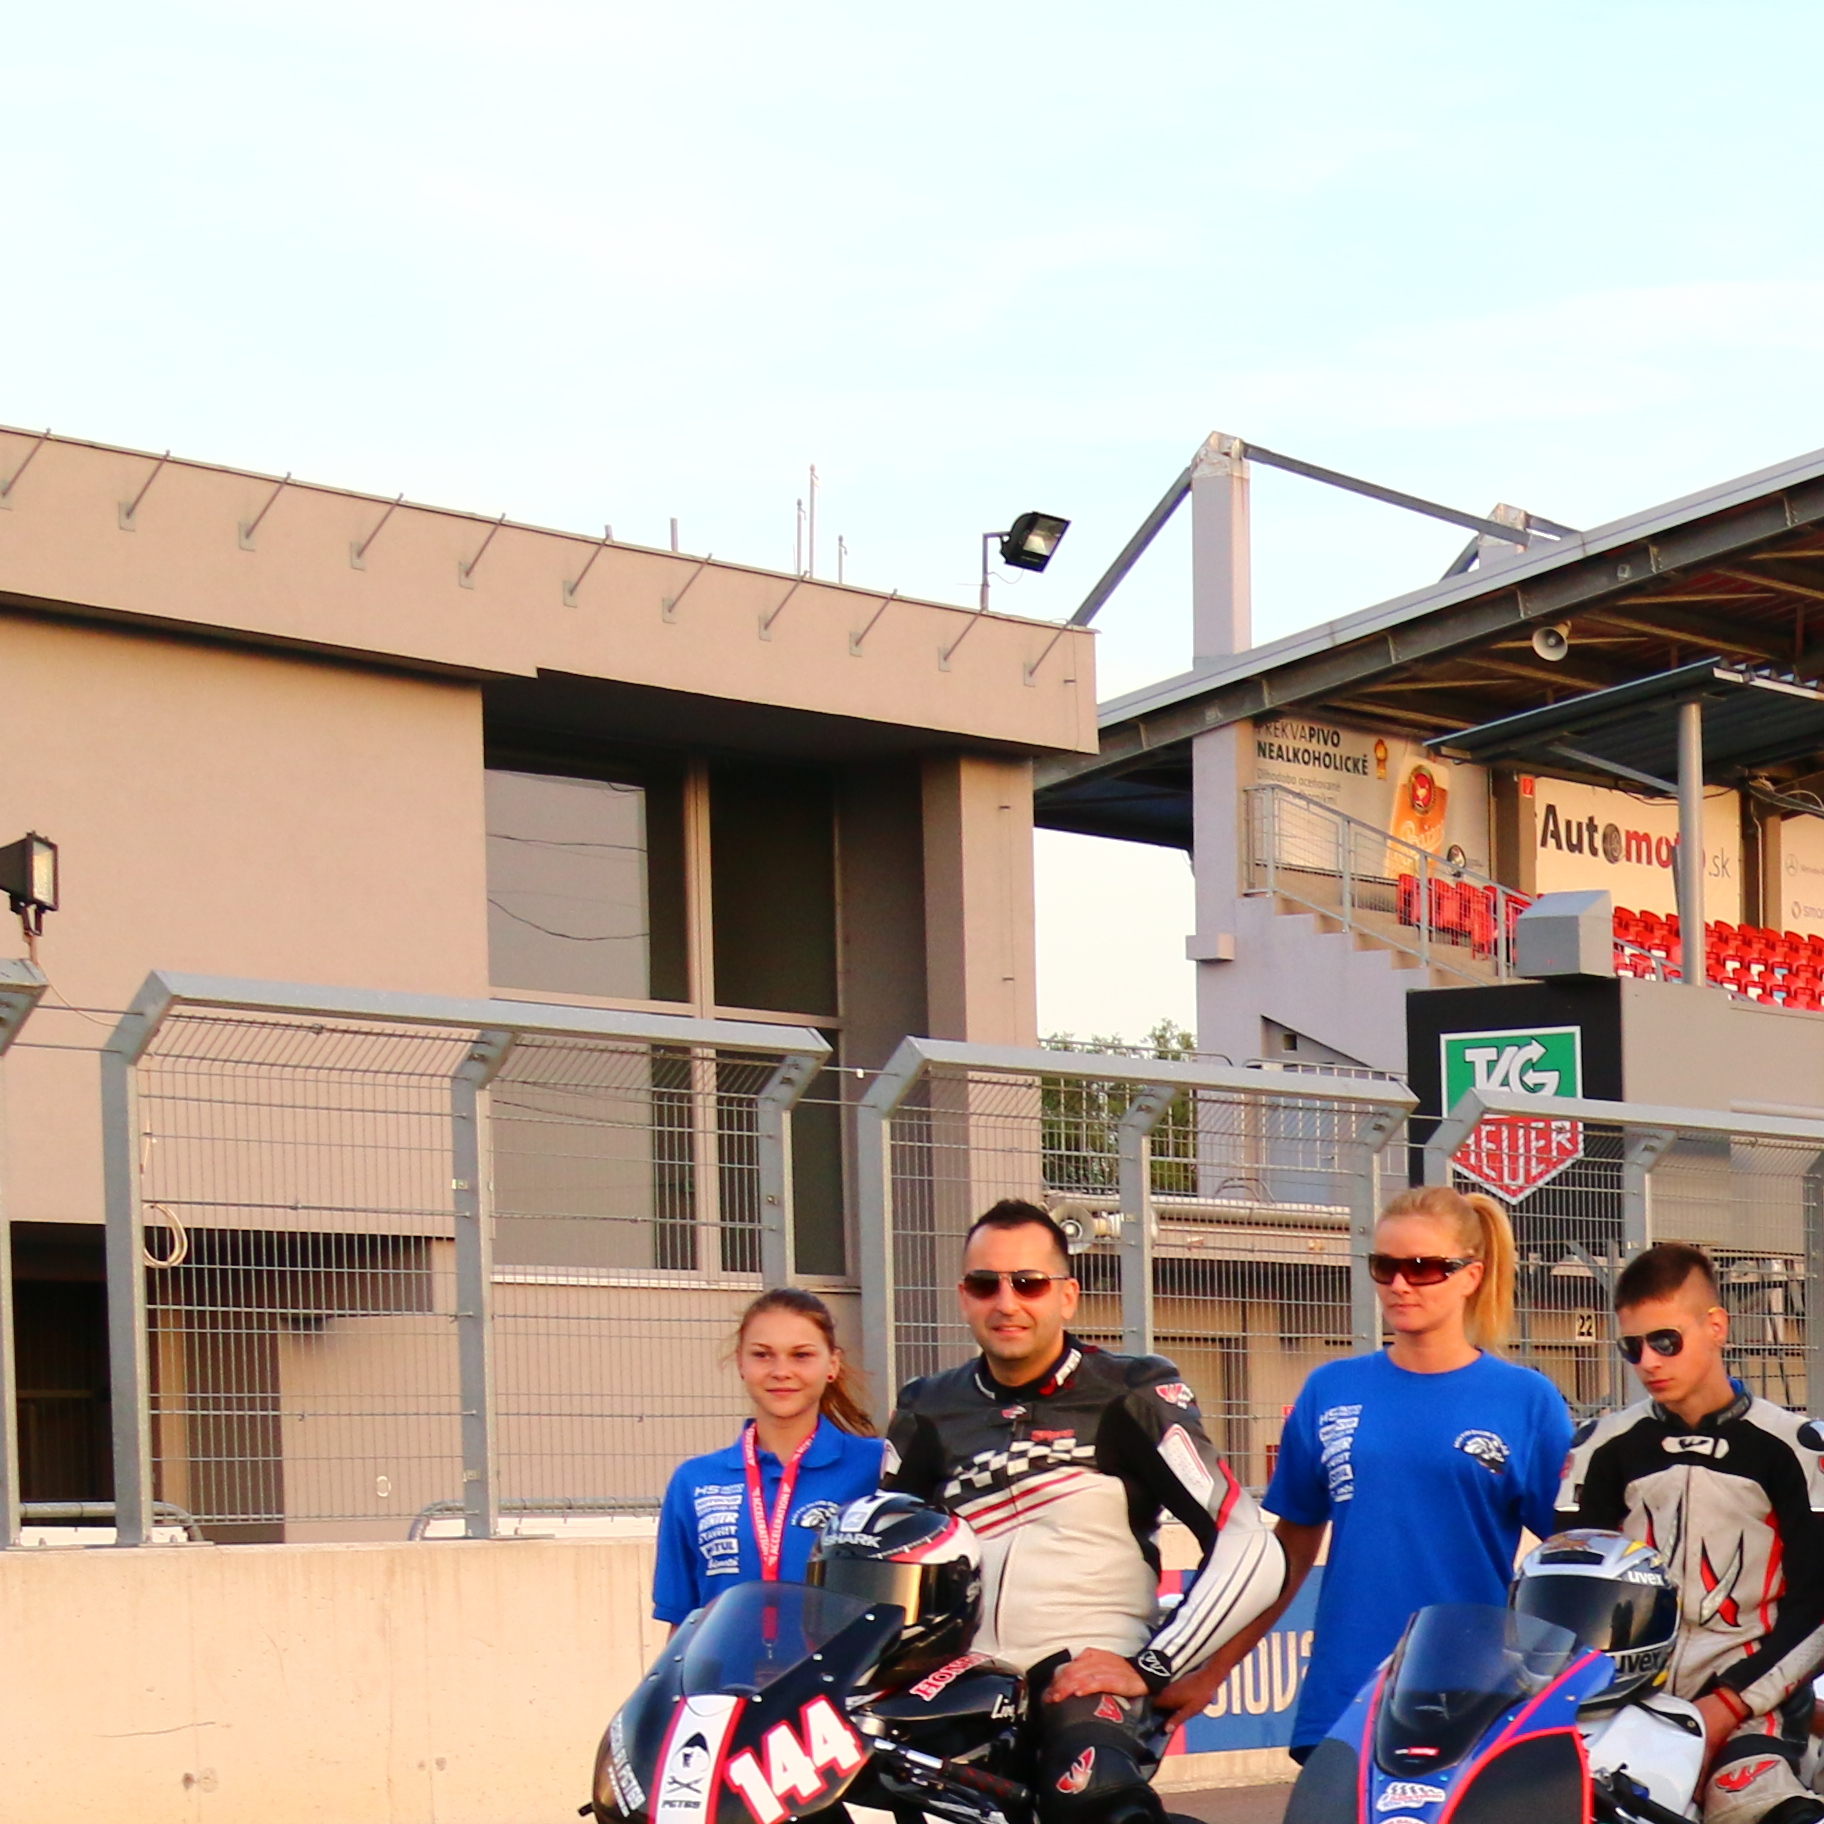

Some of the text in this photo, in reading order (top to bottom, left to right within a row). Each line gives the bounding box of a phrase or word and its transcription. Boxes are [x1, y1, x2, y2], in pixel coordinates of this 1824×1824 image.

[1256, 740, 1369, 776] NEALKOHOLICKÉ
[1577, 1315, 1593, 1337] 22
[769, 1488, 790, 1555] ACCELERATION
[823, 1533, 882, 1549] SHARK
[1627, 1571, 1664, 1586] uvex
